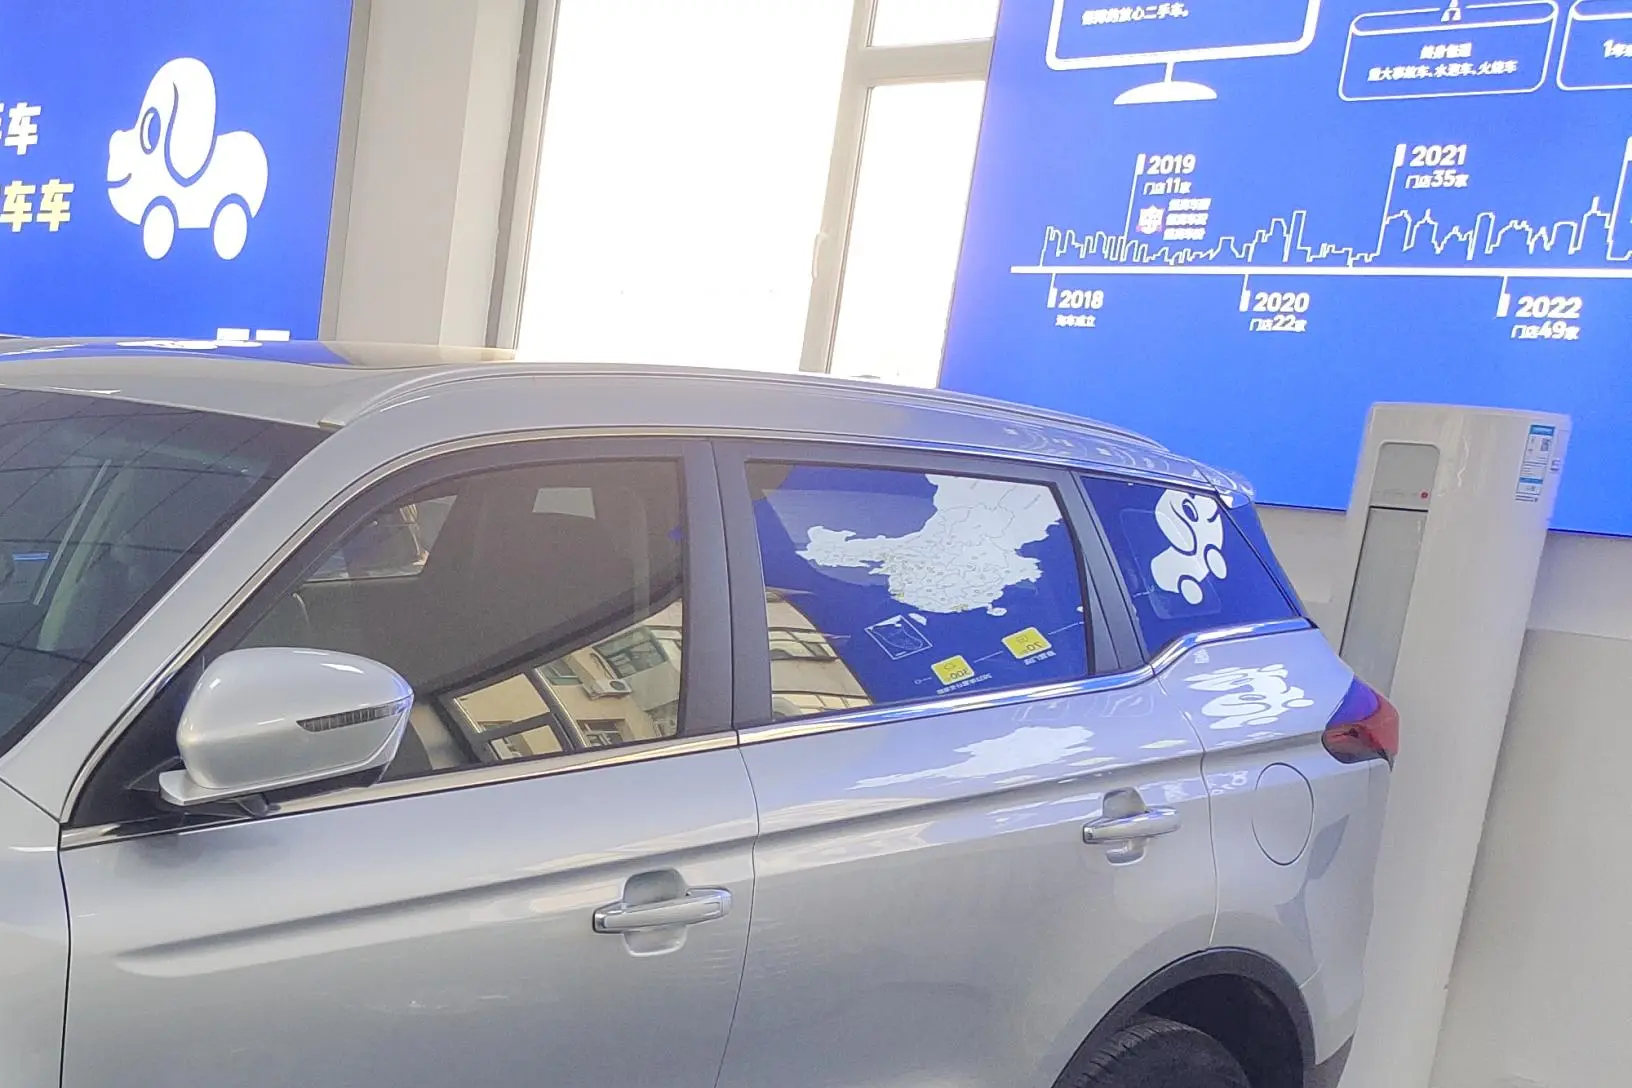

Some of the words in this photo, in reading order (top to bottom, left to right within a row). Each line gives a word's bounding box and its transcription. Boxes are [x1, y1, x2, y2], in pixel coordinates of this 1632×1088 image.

[1146, 153, 1196, 175] 2019
[1409, 144, 1468, 166] 2021
[1058, 289, 1105, 310] 2018
[1252, 291, 1311, 313] 2020
[1515, 295, 1584, 319] 2022
